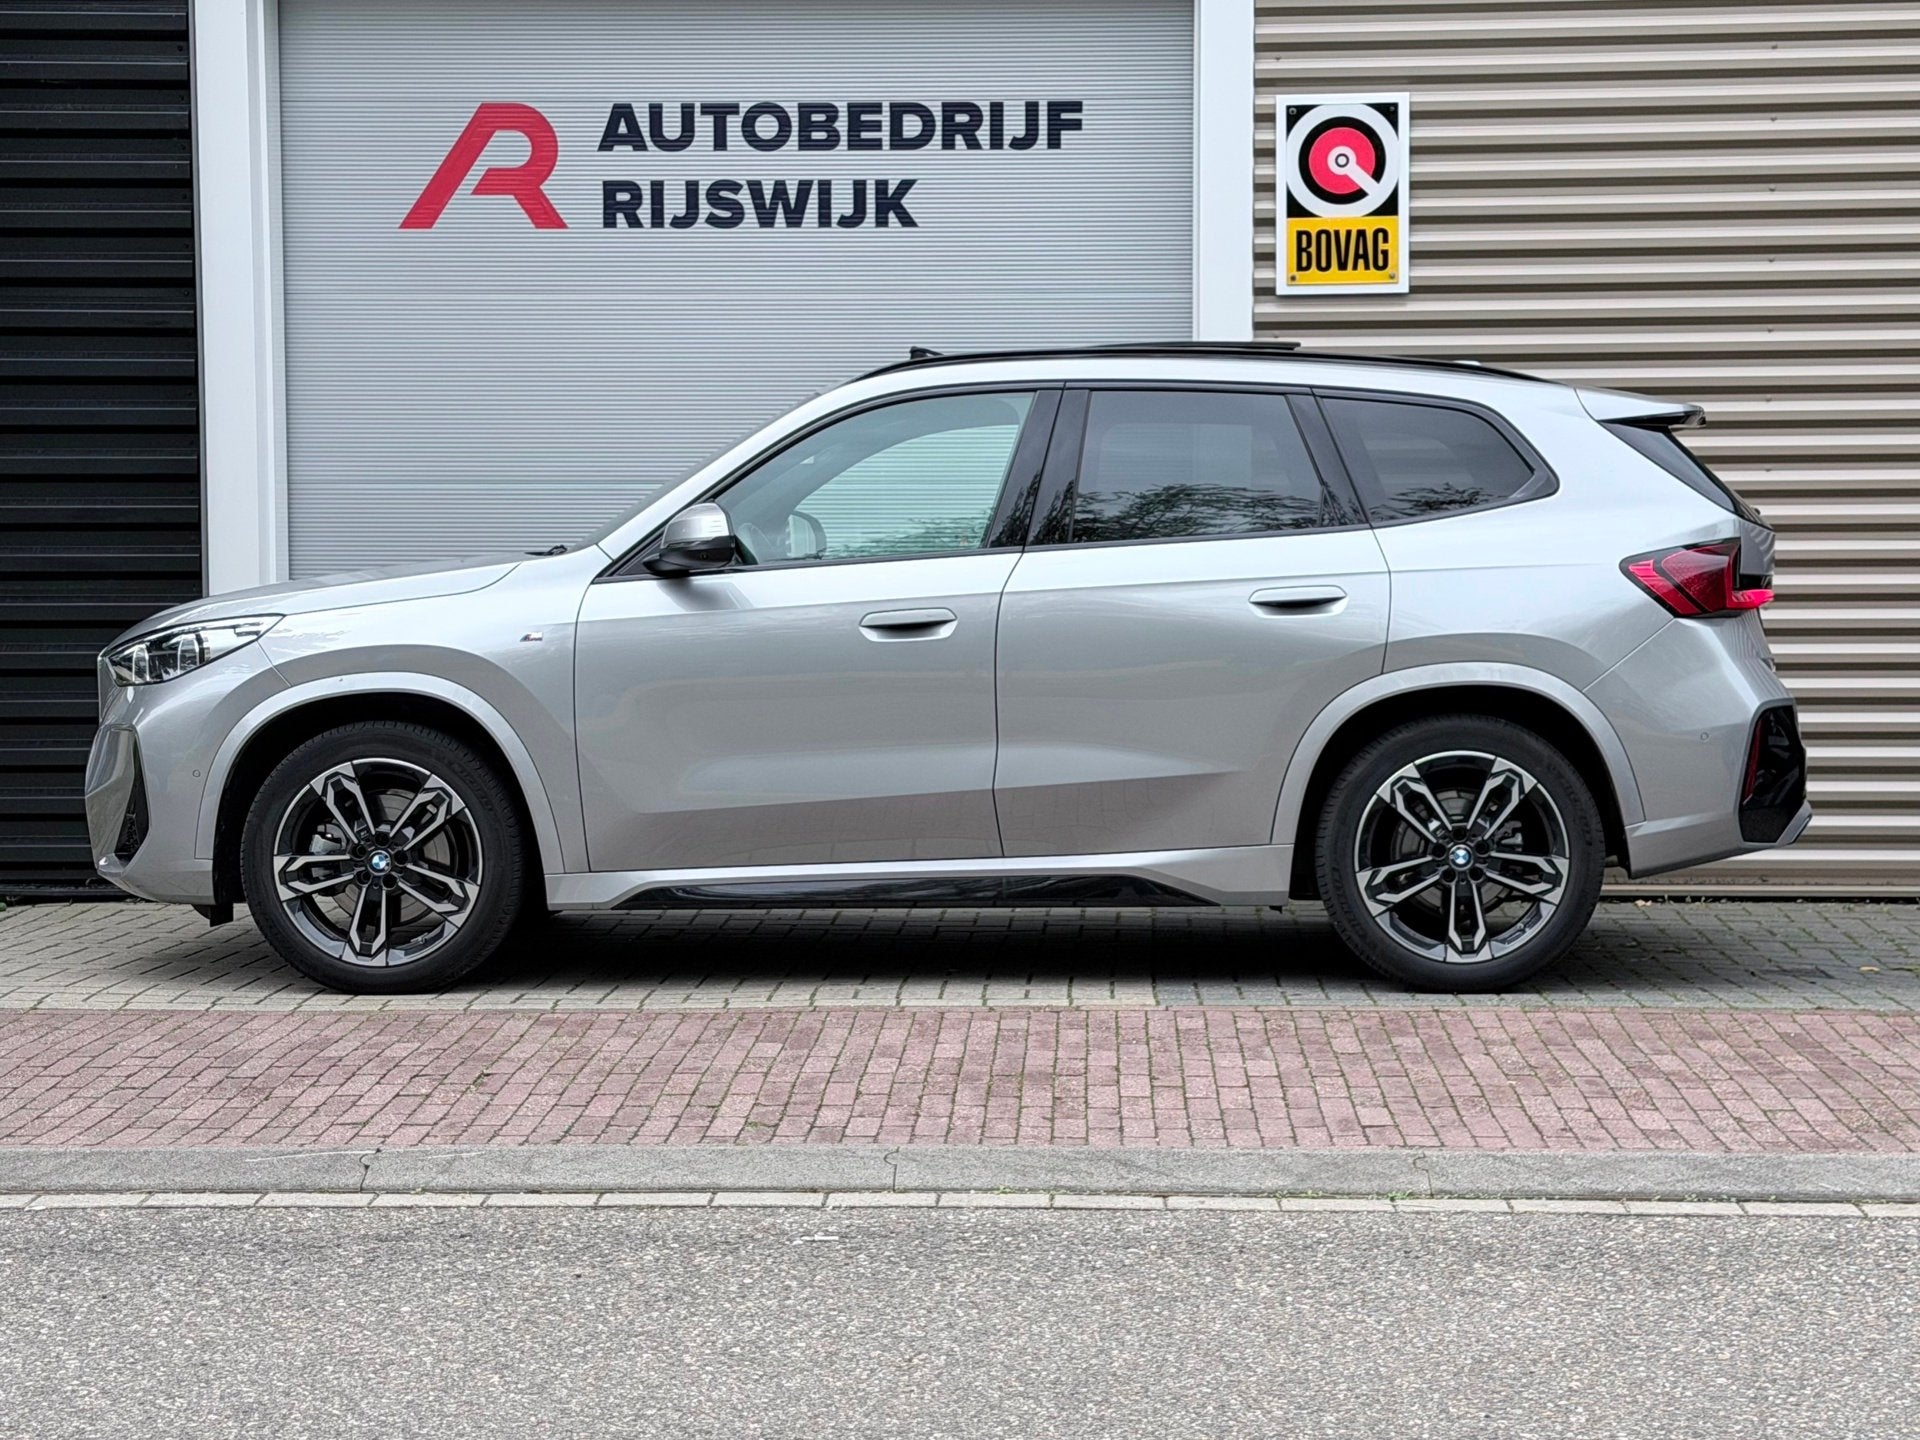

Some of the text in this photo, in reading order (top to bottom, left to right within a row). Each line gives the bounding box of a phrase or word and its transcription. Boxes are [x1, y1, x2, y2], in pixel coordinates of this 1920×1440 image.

[597, 101, 1084, 152] AUTOBEDRIJF
[602, 179, 919, 229] RIJSWIJK
[1296, 228, 1389, 272] BOVAG
